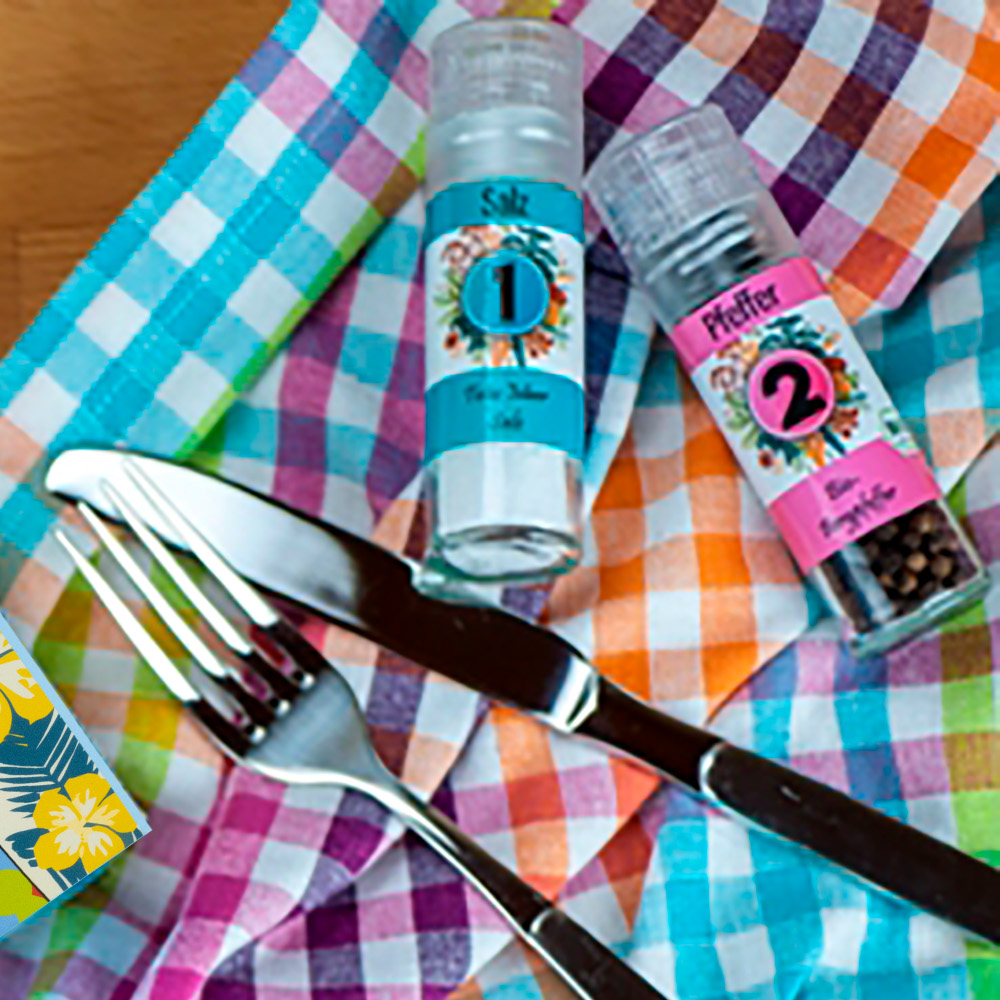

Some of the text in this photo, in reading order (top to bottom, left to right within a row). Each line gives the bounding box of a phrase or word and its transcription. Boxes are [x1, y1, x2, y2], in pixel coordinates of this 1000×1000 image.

[481, 184, 531, 218] Salz
[491, 263, 516, 322] 1
[701, 283, 782, 342] Pfeffer
[761, 359, 828, 432] 2
